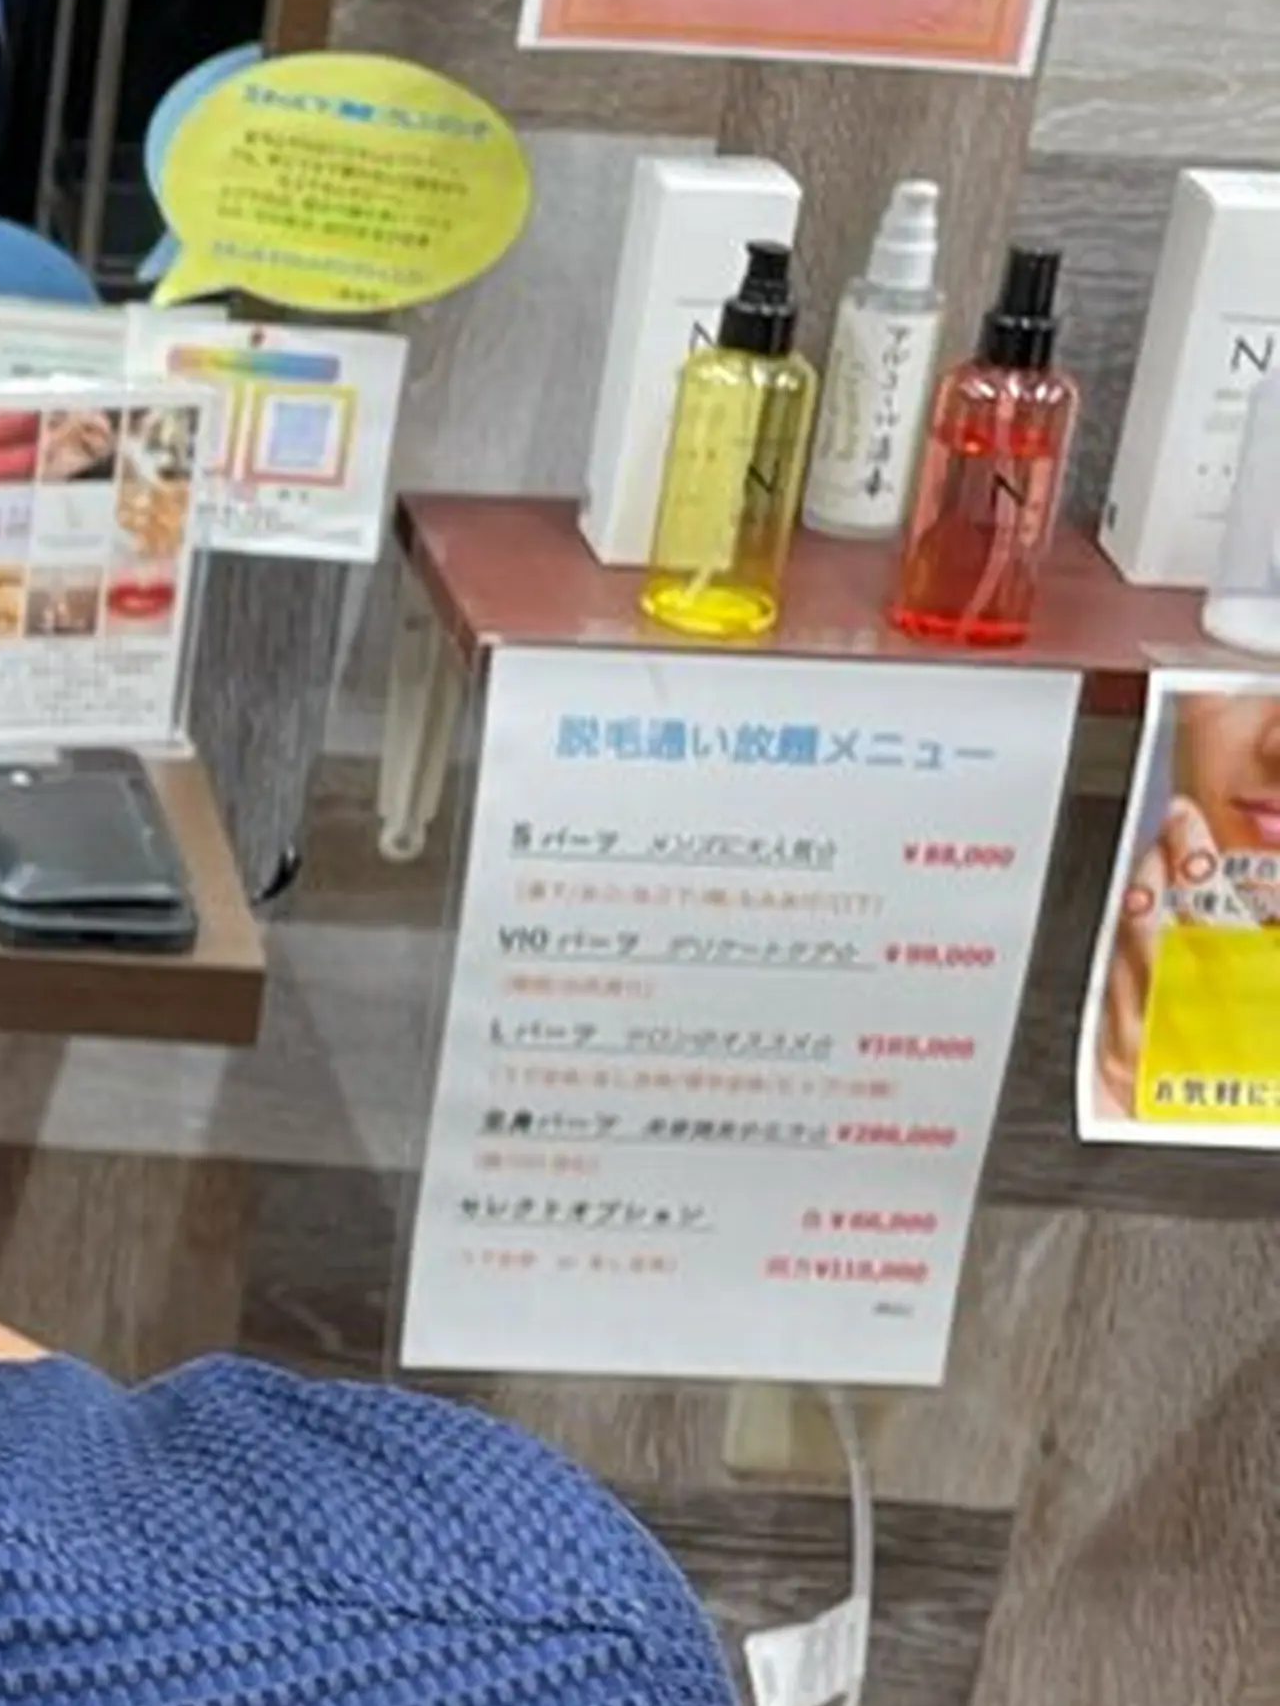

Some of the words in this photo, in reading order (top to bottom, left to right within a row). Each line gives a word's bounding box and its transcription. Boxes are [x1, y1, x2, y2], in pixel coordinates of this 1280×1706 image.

[556, 713, 998, 771] 脱毛通い放題メニュー
